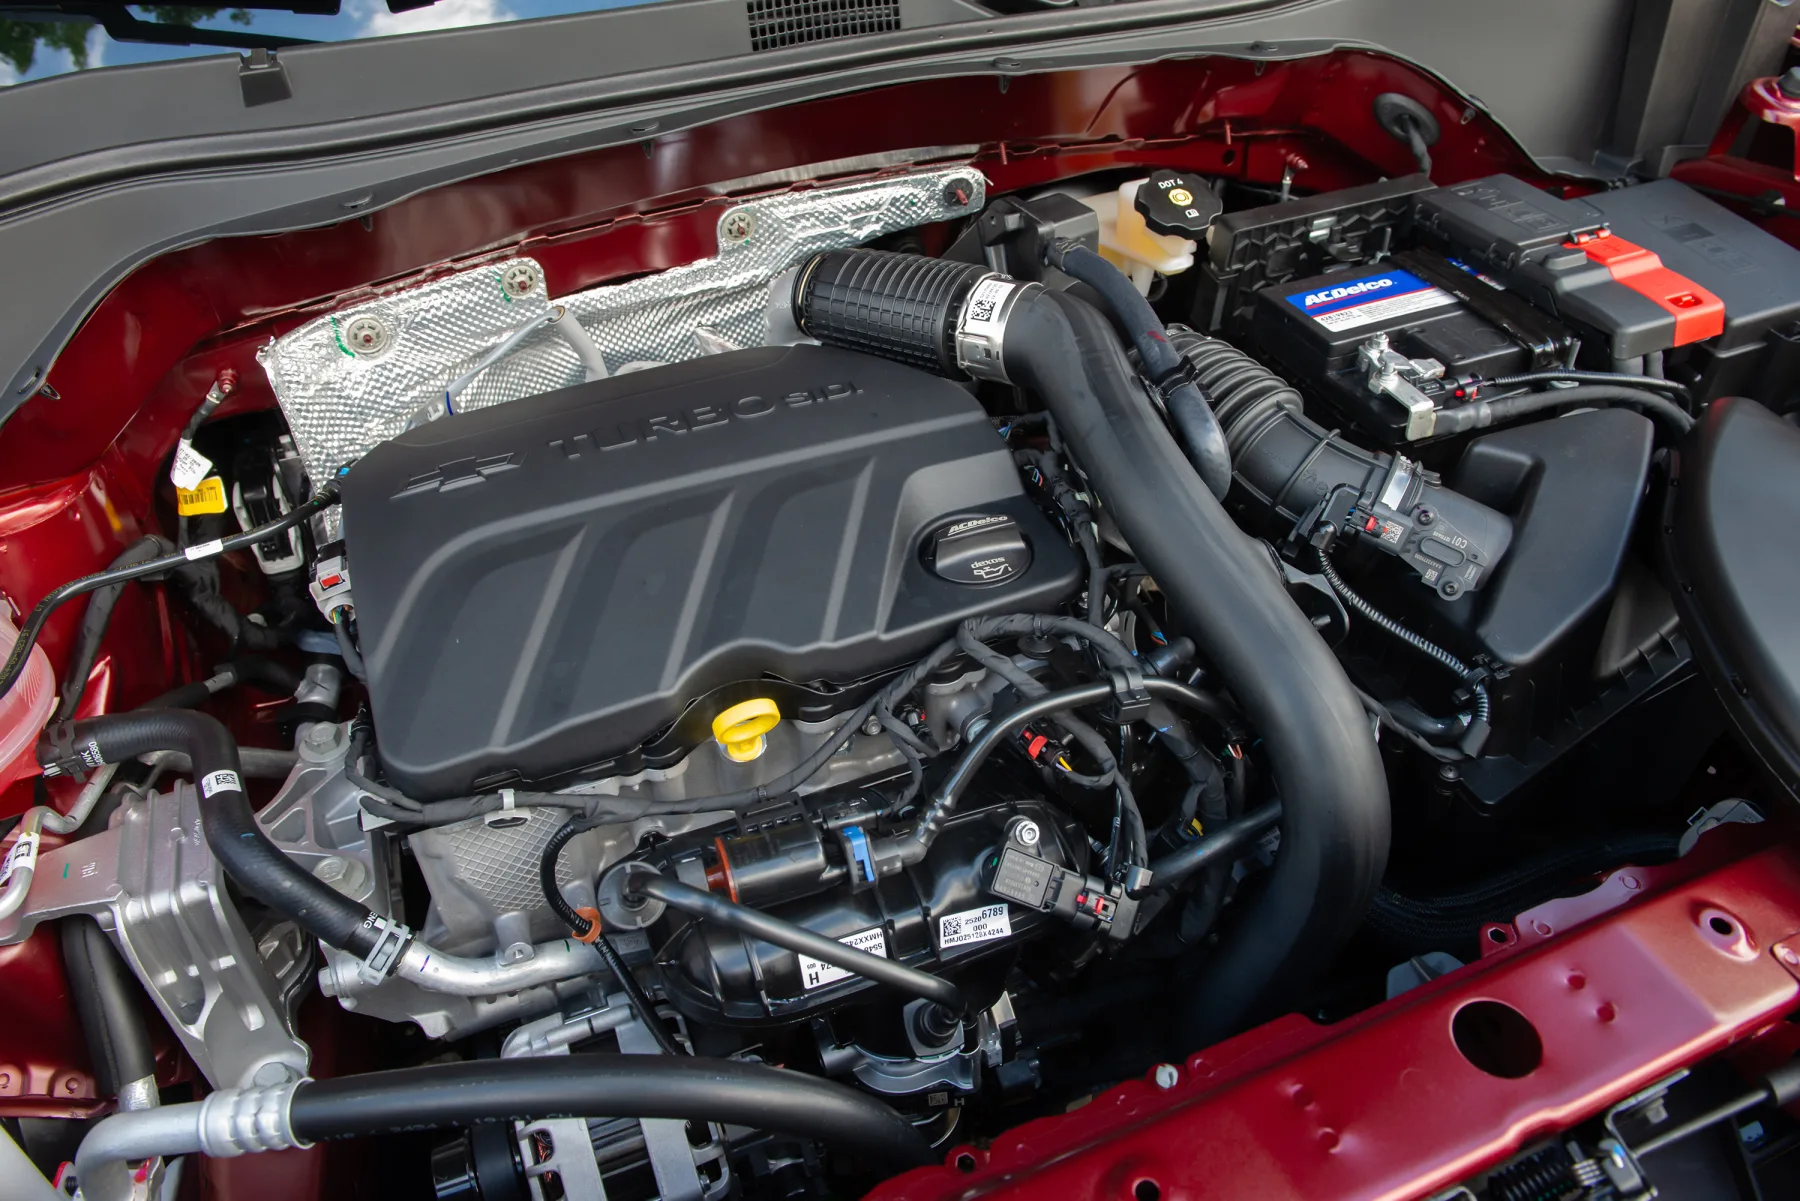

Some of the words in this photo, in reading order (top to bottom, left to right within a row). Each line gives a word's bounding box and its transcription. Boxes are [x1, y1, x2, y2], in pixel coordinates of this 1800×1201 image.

[1158, 179, 1175, 189] DOT
[1305, 278, 1393, 306] ACDelco
[549, 395, 776, 459] TURBO
[947, 516, 1008, 535] ACDelco
[1451, 535, 1468, 549] C01
[970, 557, 1006, 569] dexos
[363, 911, 378, 929] ENG
[808, 971, 820, 985] H
